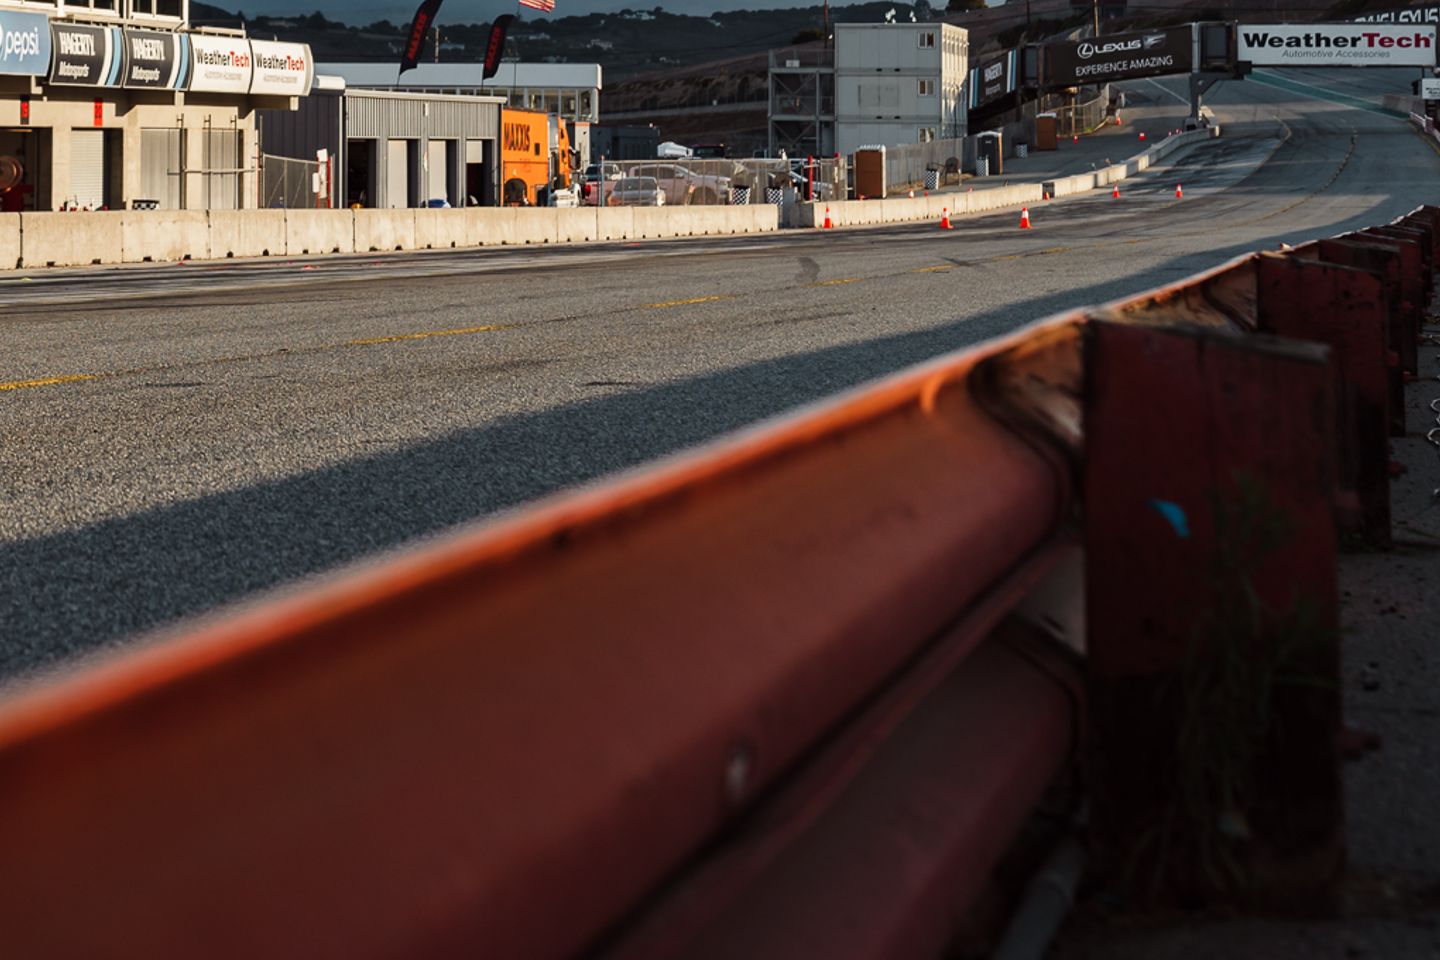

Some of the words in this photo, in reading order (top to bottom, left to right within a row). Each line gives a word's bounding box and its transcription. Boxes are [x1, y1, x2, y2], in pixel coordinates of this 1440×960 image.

[4, 27, 40, 62] pepsi
[1095, 40, 1142, 54] LEXUS
[1243, 32, 1431, 49] WeatherTech
[195, 47, 250, 68] WeatherTech
[255, 52, 305, 72] WeatherTech
[1282, 50, 1332, 58] Automotive
[1335, 50, 1391, 58] Accessories
[1076, 60, 1128, 76] EXPERIENCE
[1129, 55, 1173, 69] AMAZING
[503, 122, 530, 152] MAXXIS
